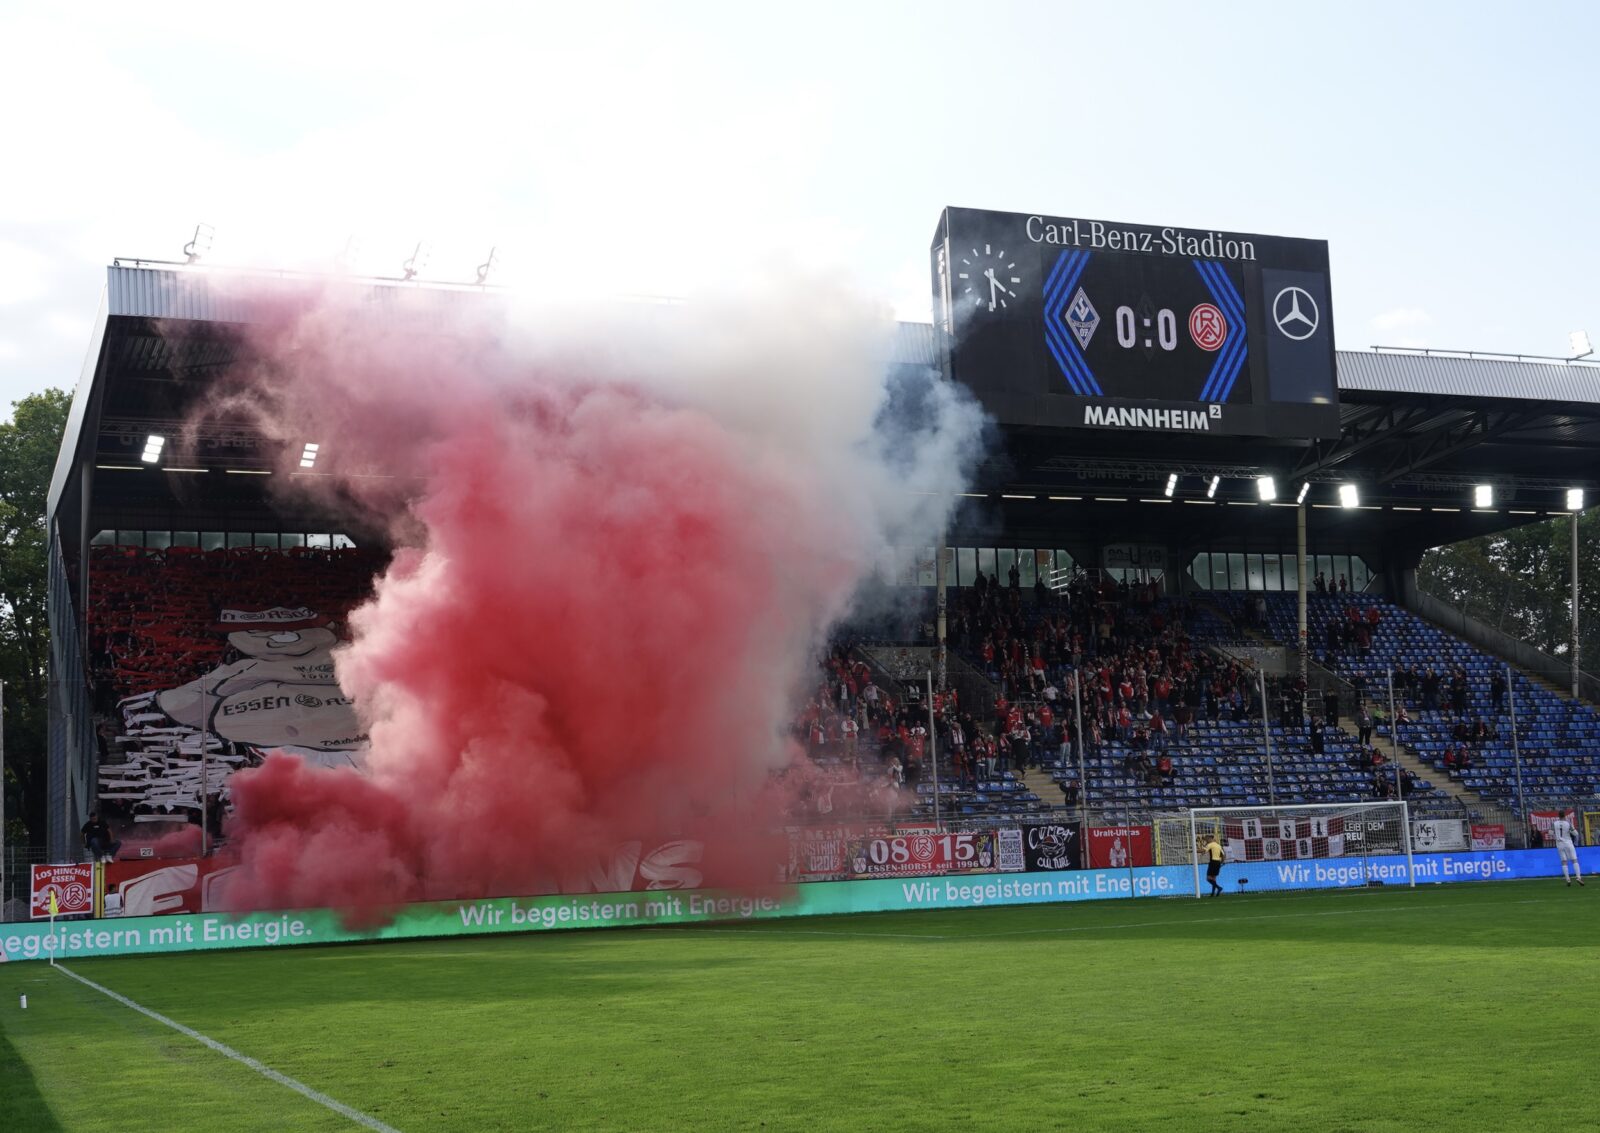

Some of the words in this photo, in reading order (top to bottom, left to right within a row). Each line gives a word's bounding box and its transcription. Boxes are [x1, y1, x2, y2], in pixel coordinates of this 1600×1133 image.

[1026, 215, 1256, 261] Carl-Benz-Stadion
[1116, 305, 1177, 351] 0:0
[1083, 405, 1209, 430] MANNHEIM
[223, 696, 290, 716] ESSEN
[1093, 829, 1140, 838] Uralt-Ultas
[1344, 832, 1363, 841] REU
[1367, 822, 1384, 831] DEM
[869, 838, 910, 865] 08
[938, 835, 975, 861] 15
[868, 861, 933, 873] ESSEN-HORST
[936, 860, 953, 869] seit
[956, 860, 979, 869] 1996
[1037, 855, 1071, 869] CULTURE
[1277, 863, 1311, 883] Wir
[1315, 861, 1406, 885] begeistern
[1412, 857, 1438, 876] mit
[1443, 855, 1511, 877] Energie.
[35, 869, 53, 881] LOS
[53, 867, 90, 878] HINCHAS
[51, 875, 76, 883] ESSEN
[902, 882, 940, 903] Wir
[946, 878, 1052, 903] begeistern
[1058, 875, 1089, 898] mit
[1095, 871, 1174, 896] Energie.
[459, 903, 504, 927] Wir
[511, 900, 639, 929] begeistern
[645, 895, 682, 918] mit
[690, 894, 780, 918] Energie.
[0, 926, 140, 958] egeistern
[149, 920, 193, 945] mit
[203, 914, 313, 943] Energie.
